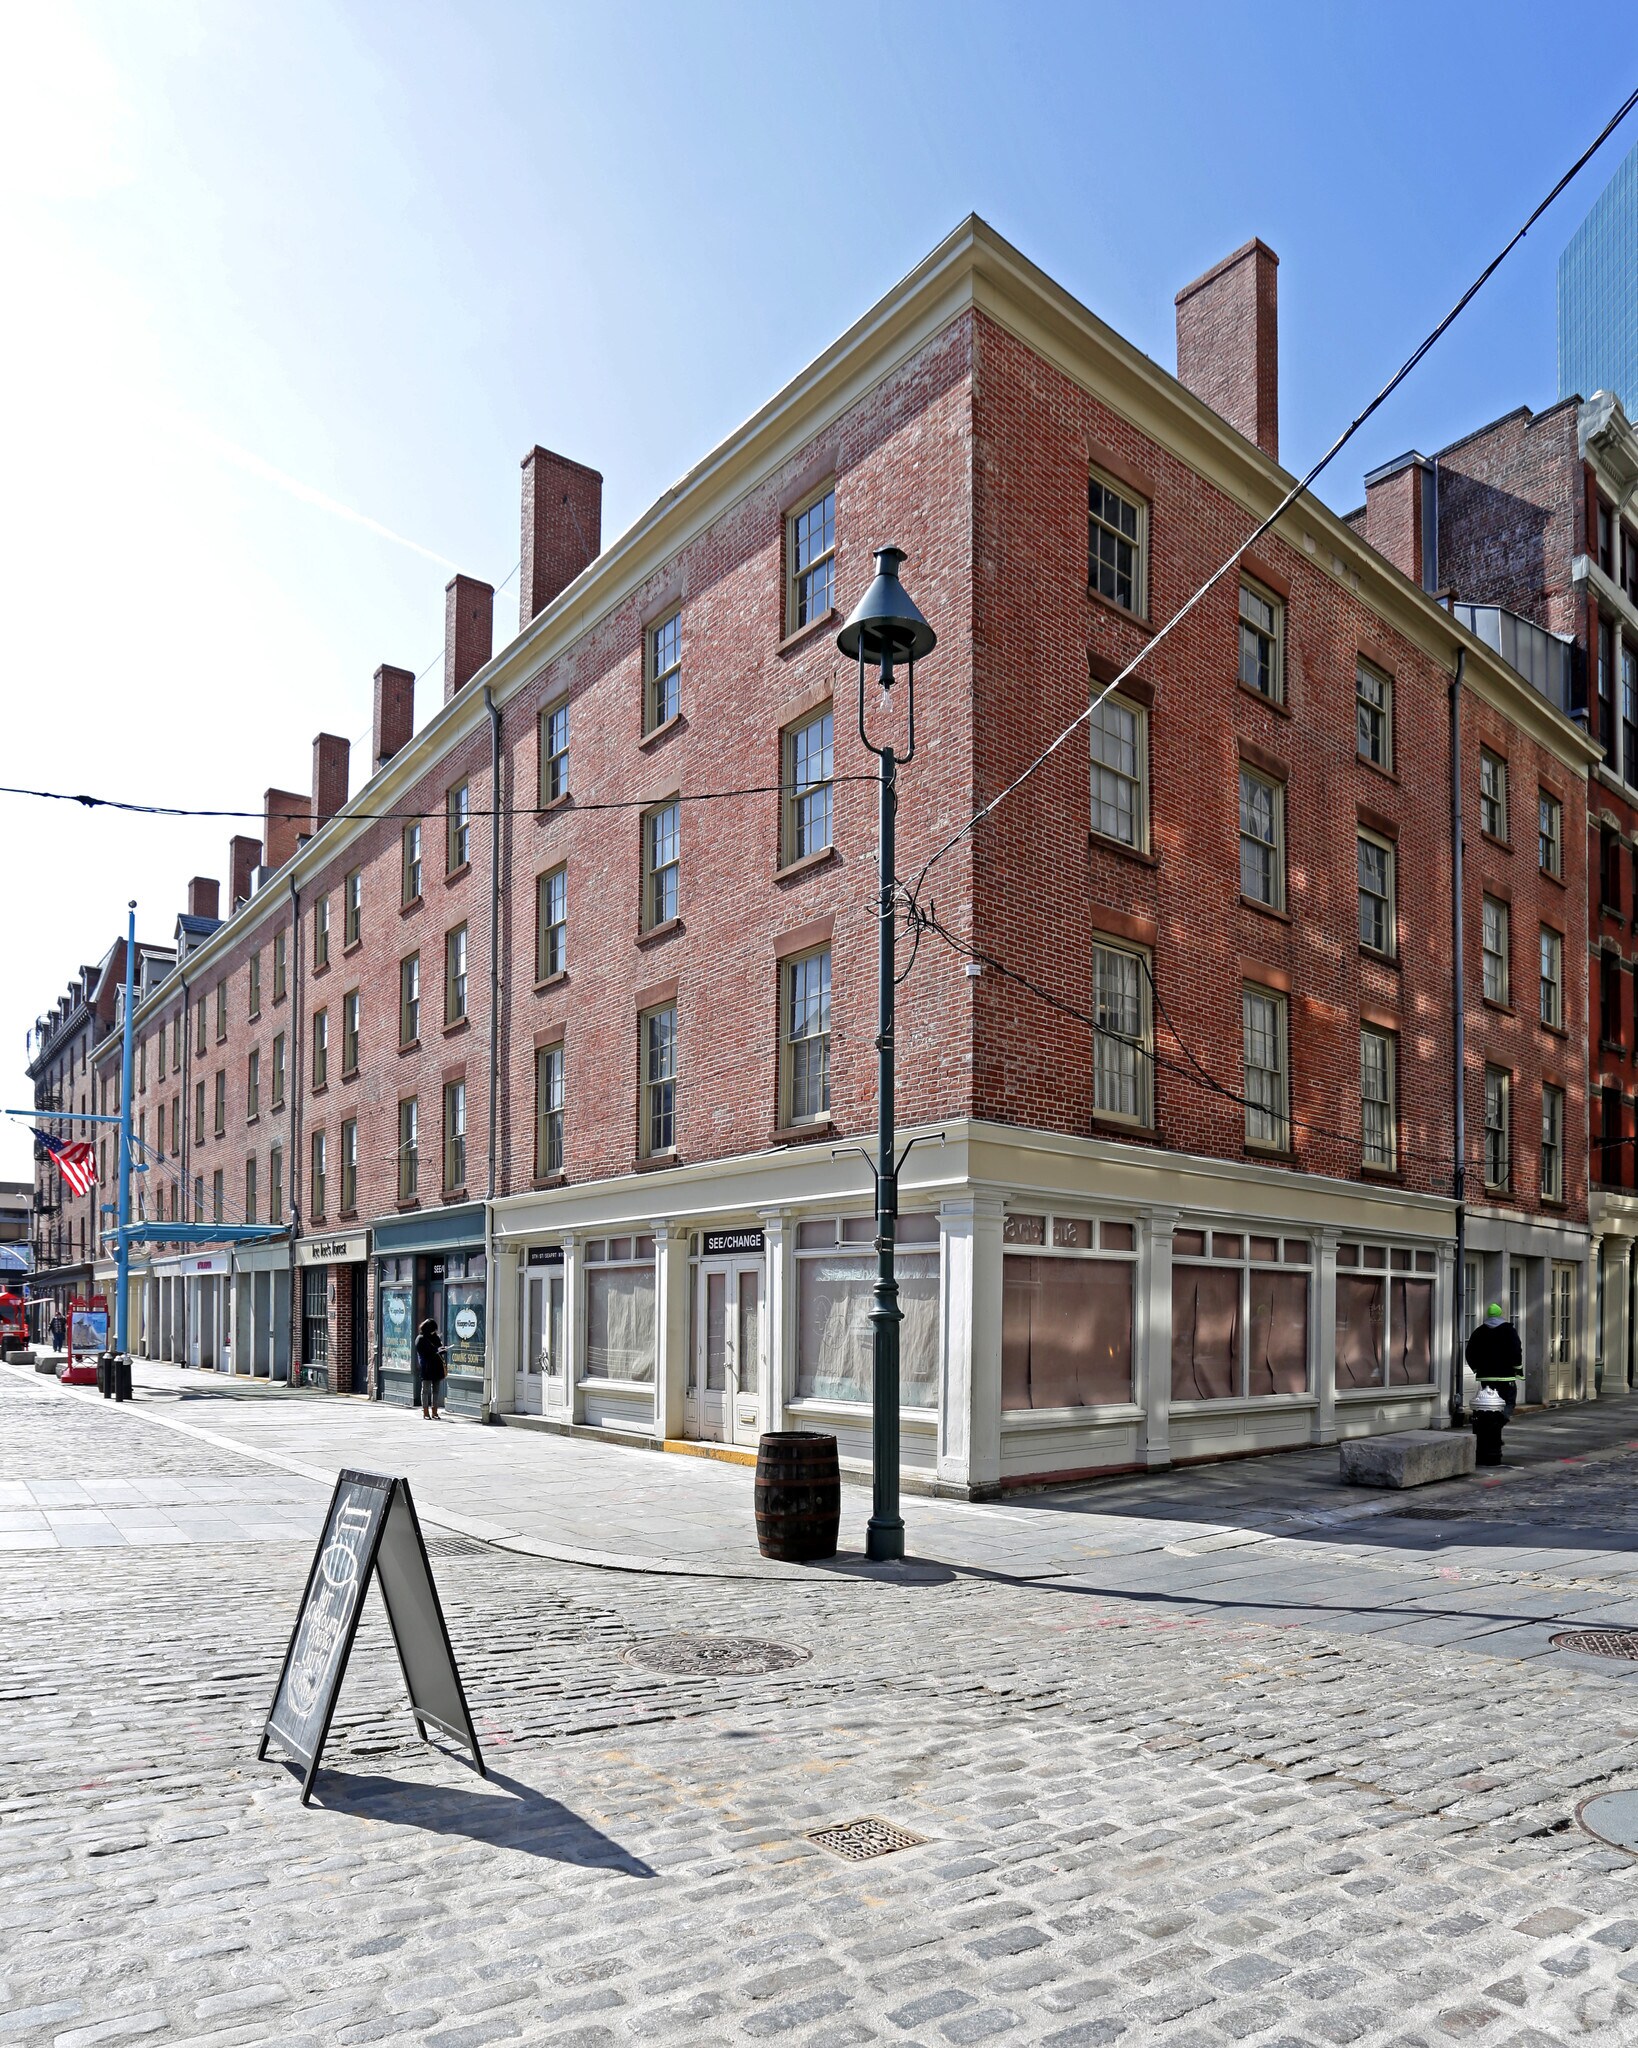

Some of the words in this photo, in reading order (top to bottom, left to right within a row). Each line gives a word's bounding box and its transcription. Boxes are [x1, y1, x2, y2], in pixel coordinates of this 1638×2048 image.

[708, 1234, 761, 1249] SEE/CHANGE
[452, 1352, 467, 1363] COMING
[468, 1353, 478, 1364] SOON
